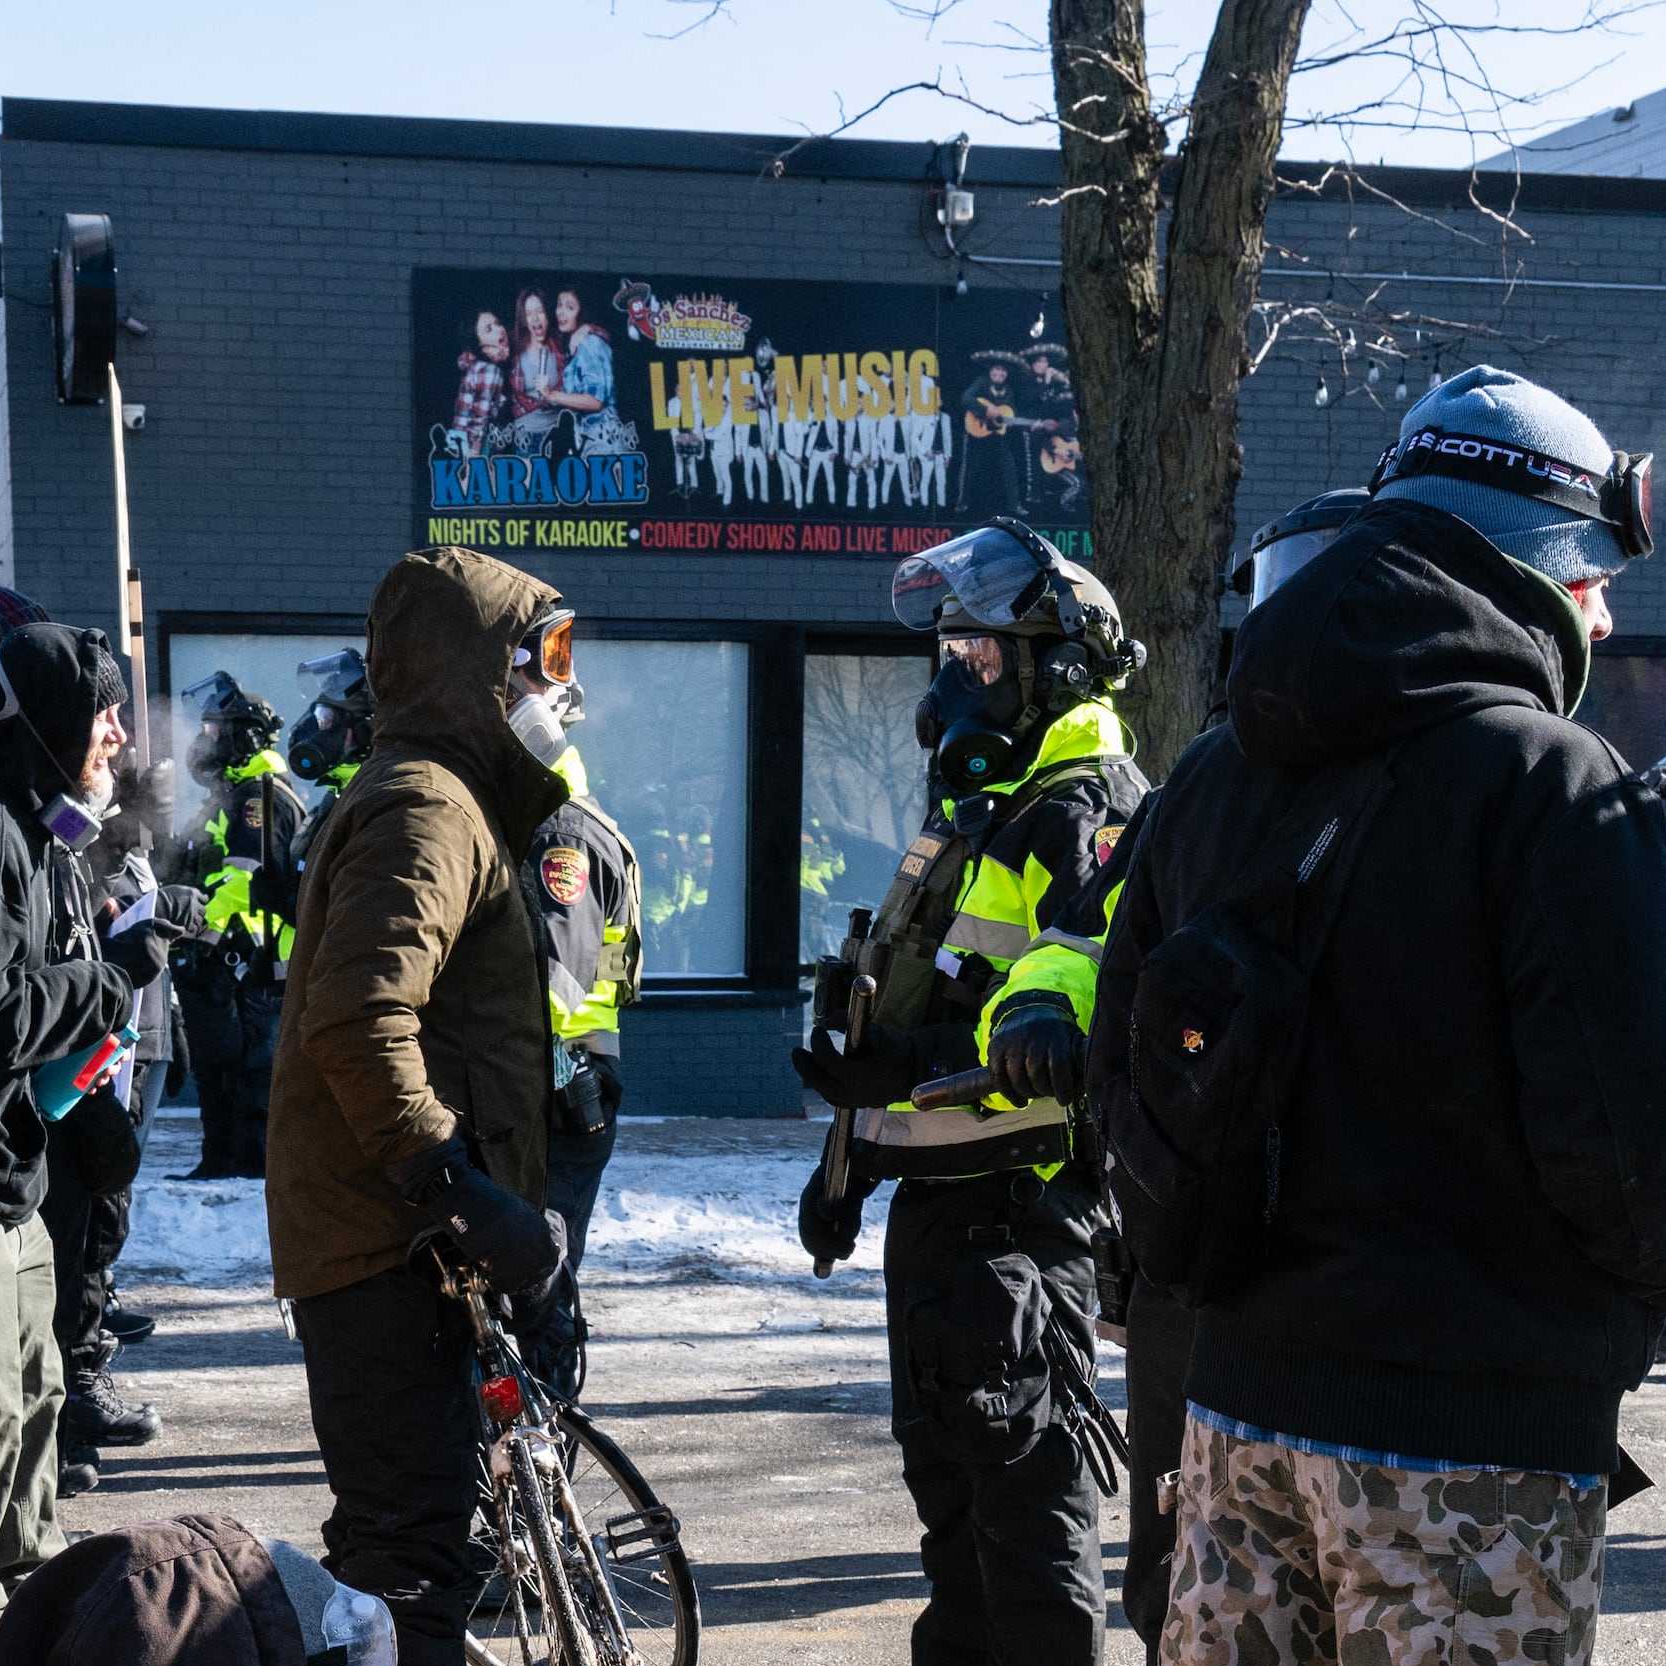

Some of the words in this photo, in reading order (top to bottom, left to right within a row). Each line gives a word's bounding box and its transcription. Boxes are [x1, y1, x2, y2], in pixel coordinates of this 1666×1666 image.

[675, 301, 751, 330] Sanchez
[660, 327, 743, 341] MEXICAN
[649, 357, 757, 431] LIVE
[774, 348, 940, 424] MUSIC
[432, 450, 649, 507] KARAOKE
[1526, 454, 1601, 501] USA
[429, 518, 501, 546] NIGHTS
[505, 520, 530, 546] OF
[535, 521, 628, 548] KARAOKE
[641, 523, 722, 550] COMEDY
[727, 524, 794, 551] SHOWS
[801, 525, 841, 551] AND
[846, 526, 888, 552] LIVE
